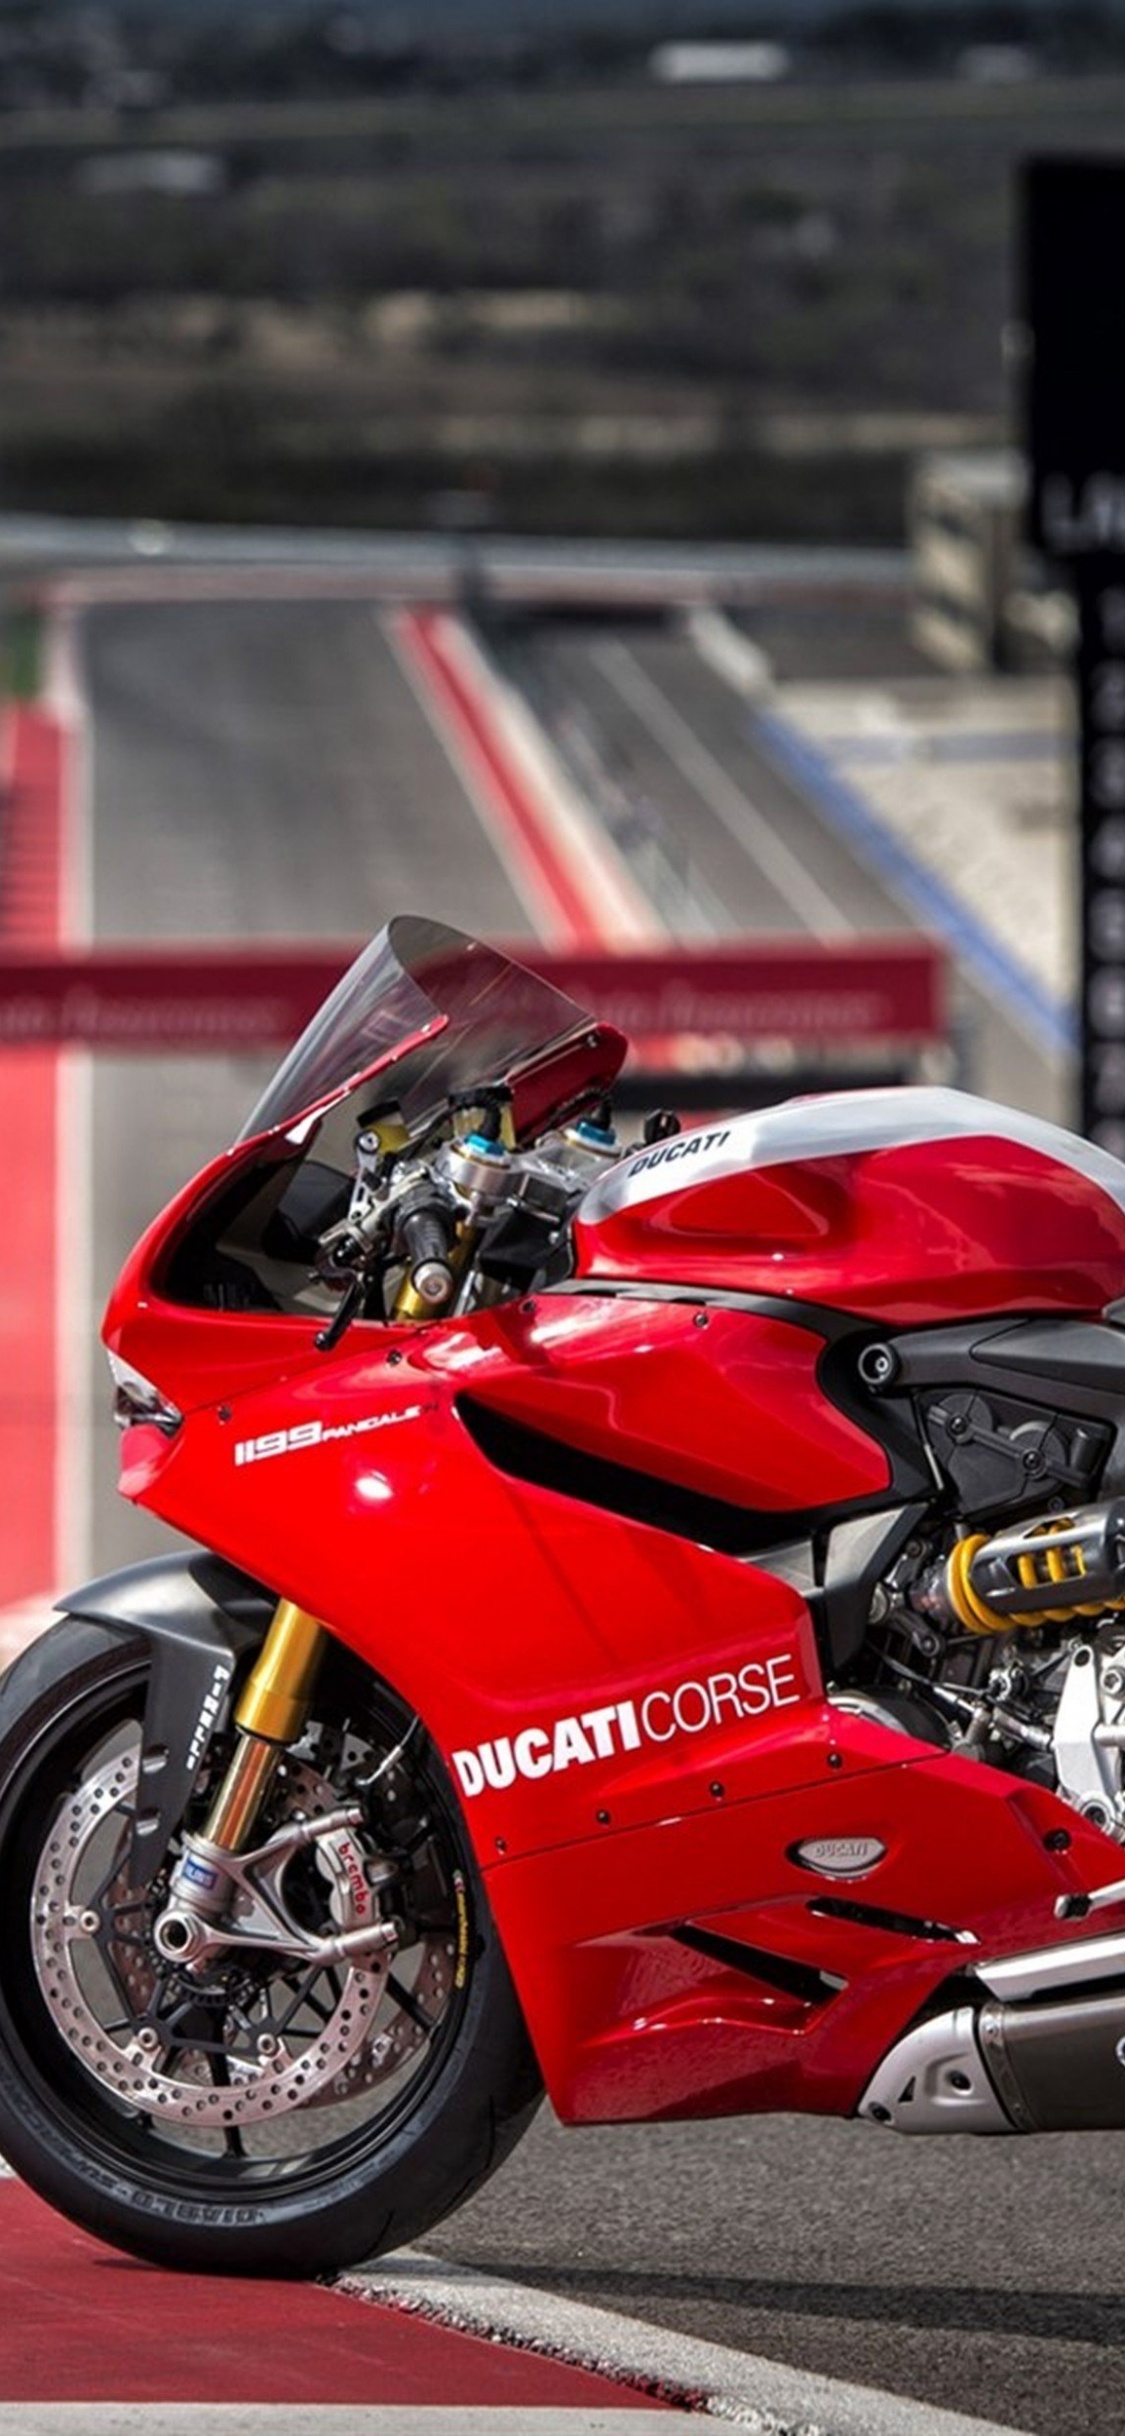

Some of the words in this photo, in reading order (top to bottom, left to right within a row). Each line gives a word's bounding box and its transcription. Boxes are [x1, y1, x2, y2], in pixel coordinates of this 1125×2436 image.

[627, 1130, 731, 1178] DUCATI
[235, 1421, 322, 1466] 1199
[452, 1700, 642, 1797] DUCATI
[641, 1653, 800, 1741] CORSE
[813, 1841, 868, 1859] DUCATI
[338, 1842, 369, 1915] brembo
